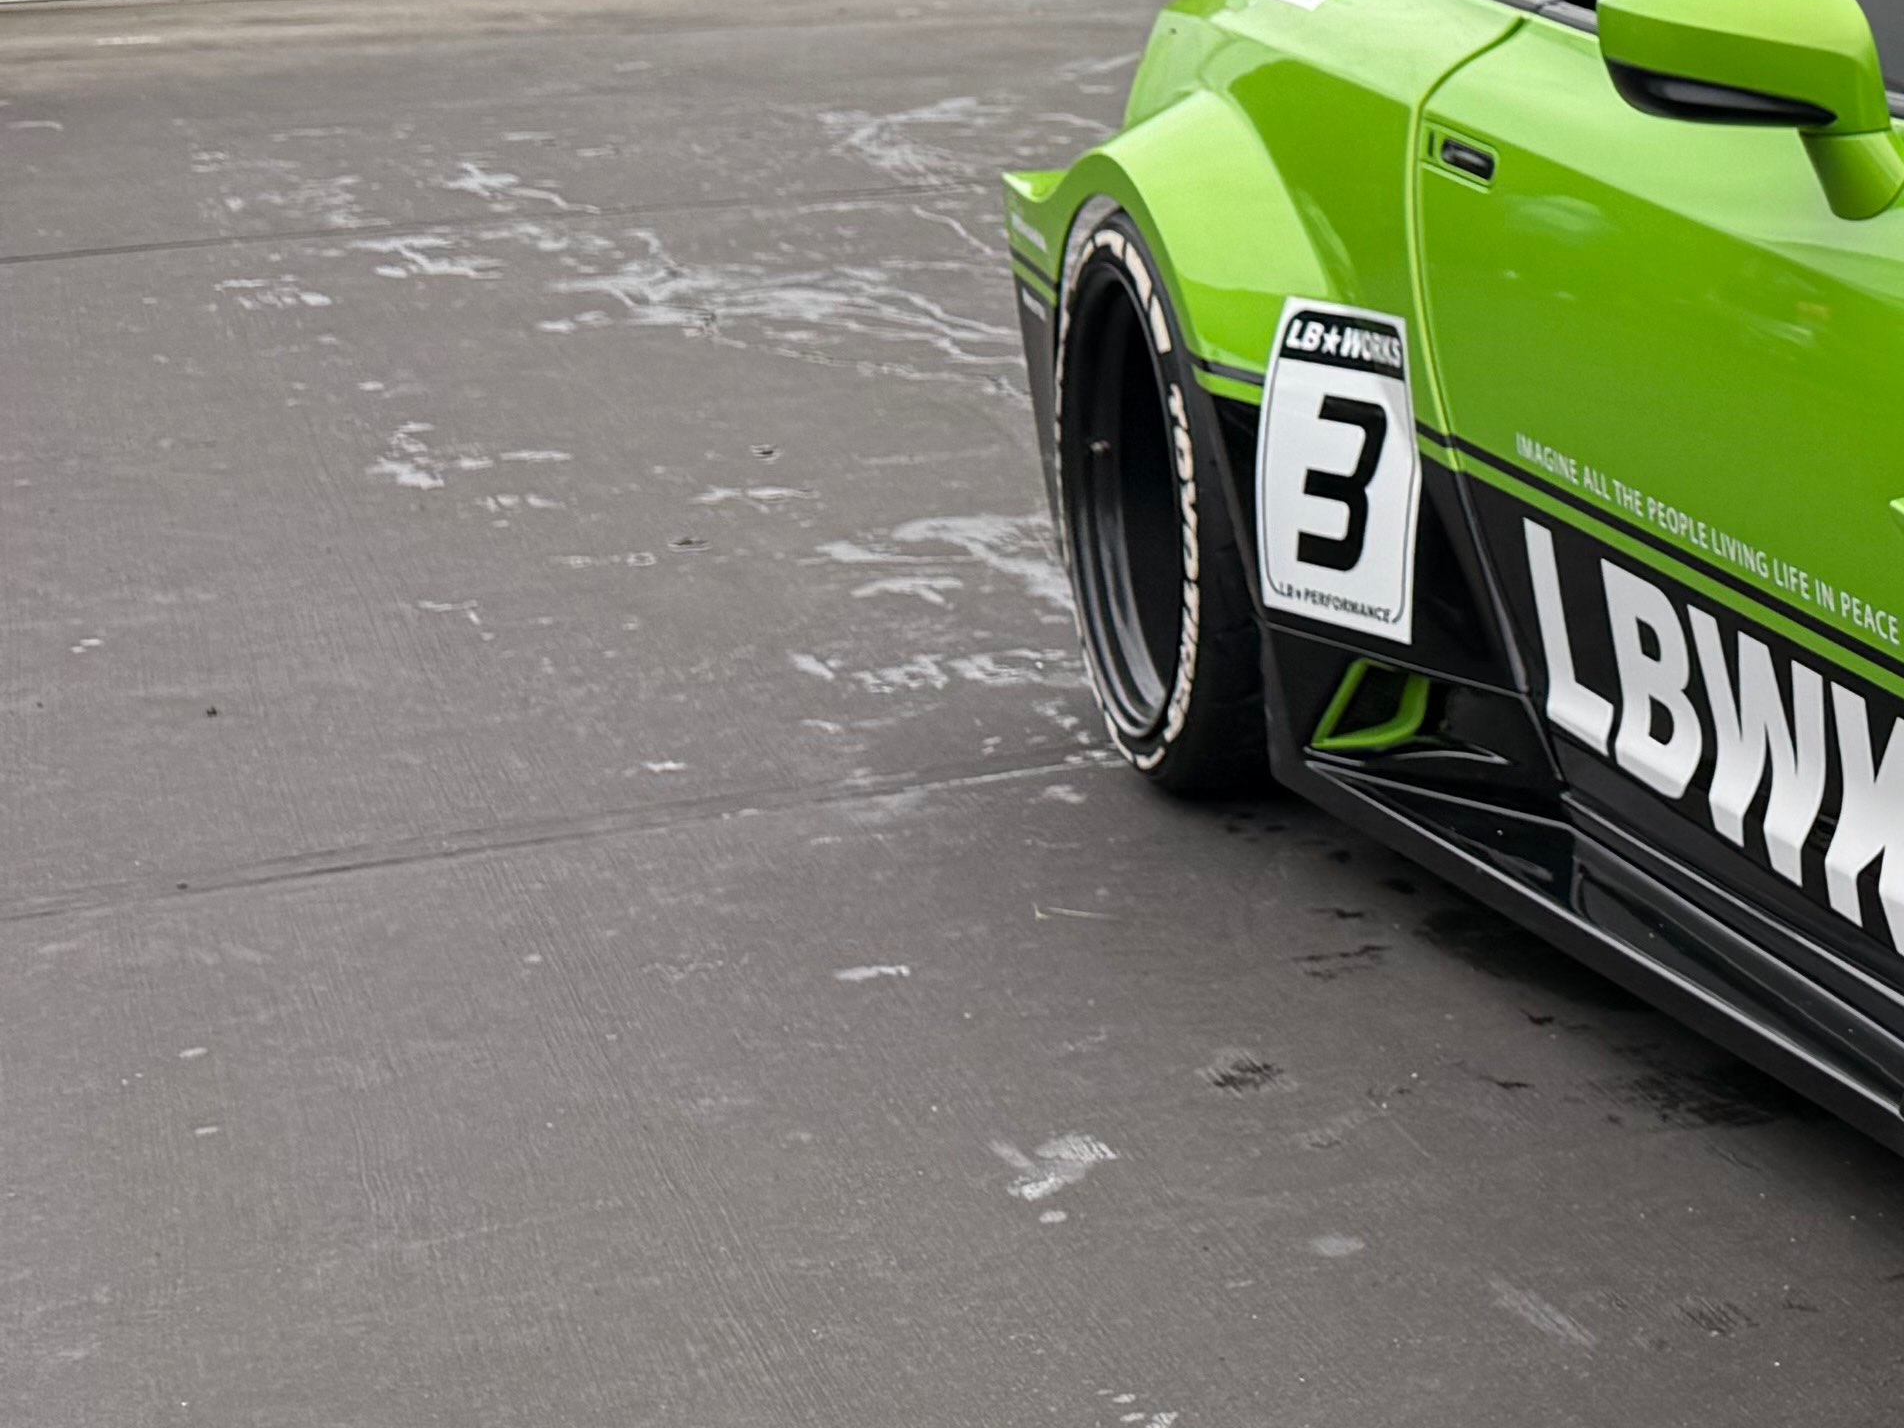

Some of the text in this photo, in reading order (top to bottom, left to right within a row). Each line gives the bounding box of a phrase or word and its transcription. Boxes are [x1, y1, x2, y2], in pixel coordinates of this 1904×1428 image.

[1297, 394, 1387, 572] 3
[1516, 432, 1901, 646] IMAGINE ALL THE PEOPLE LIVING LIFE IN PEACE
